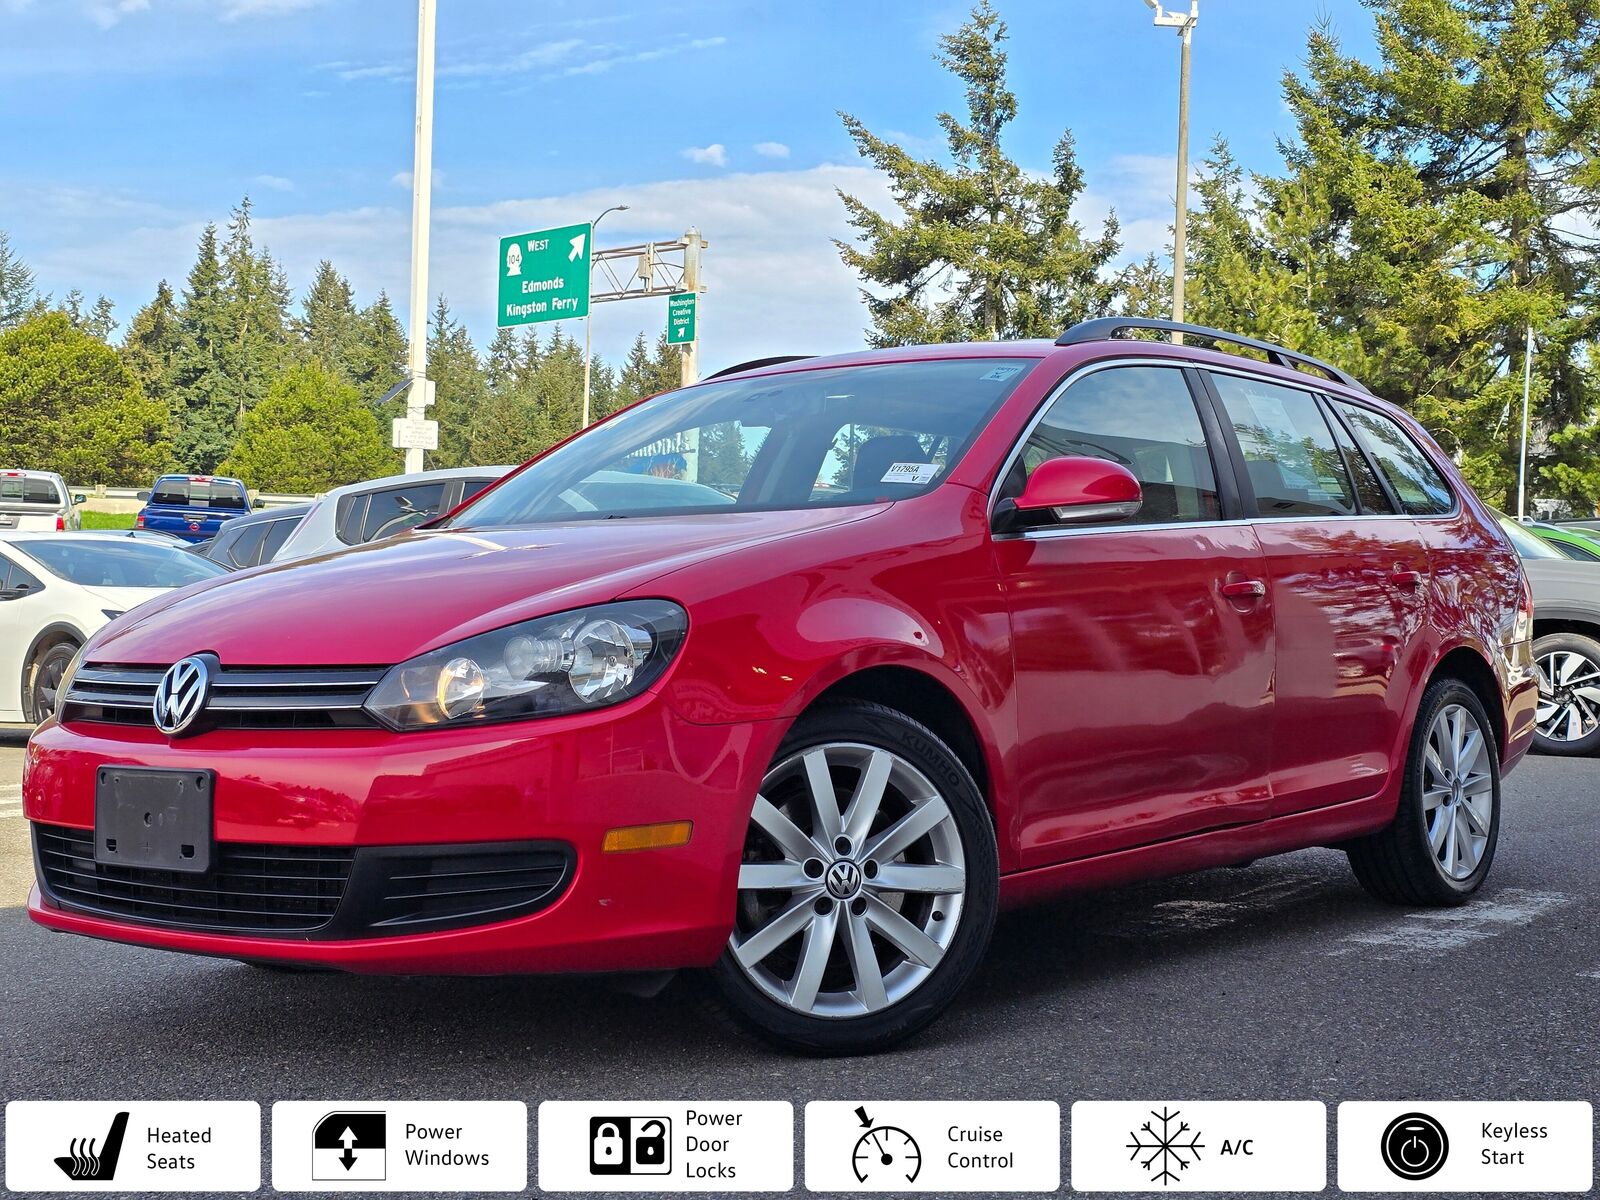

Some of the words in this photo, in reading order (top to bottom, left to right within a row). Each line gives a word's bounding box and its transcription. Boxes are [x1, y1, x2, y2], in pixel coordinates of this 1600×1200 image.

[527, 239, 550, 252] WEST
[508, 254, 520, 266] 104
[522, 276, 564, 293] Edmonds
[506, 301, 547, 318] Kingston
[552, 297, 578, 311] Ferry
[890, 465, 920, 473] V1795A
[153, 656, 208, 734] VW
[902, 732, 960, 786] KUMHO
[826, 862, 860, 897] VW
